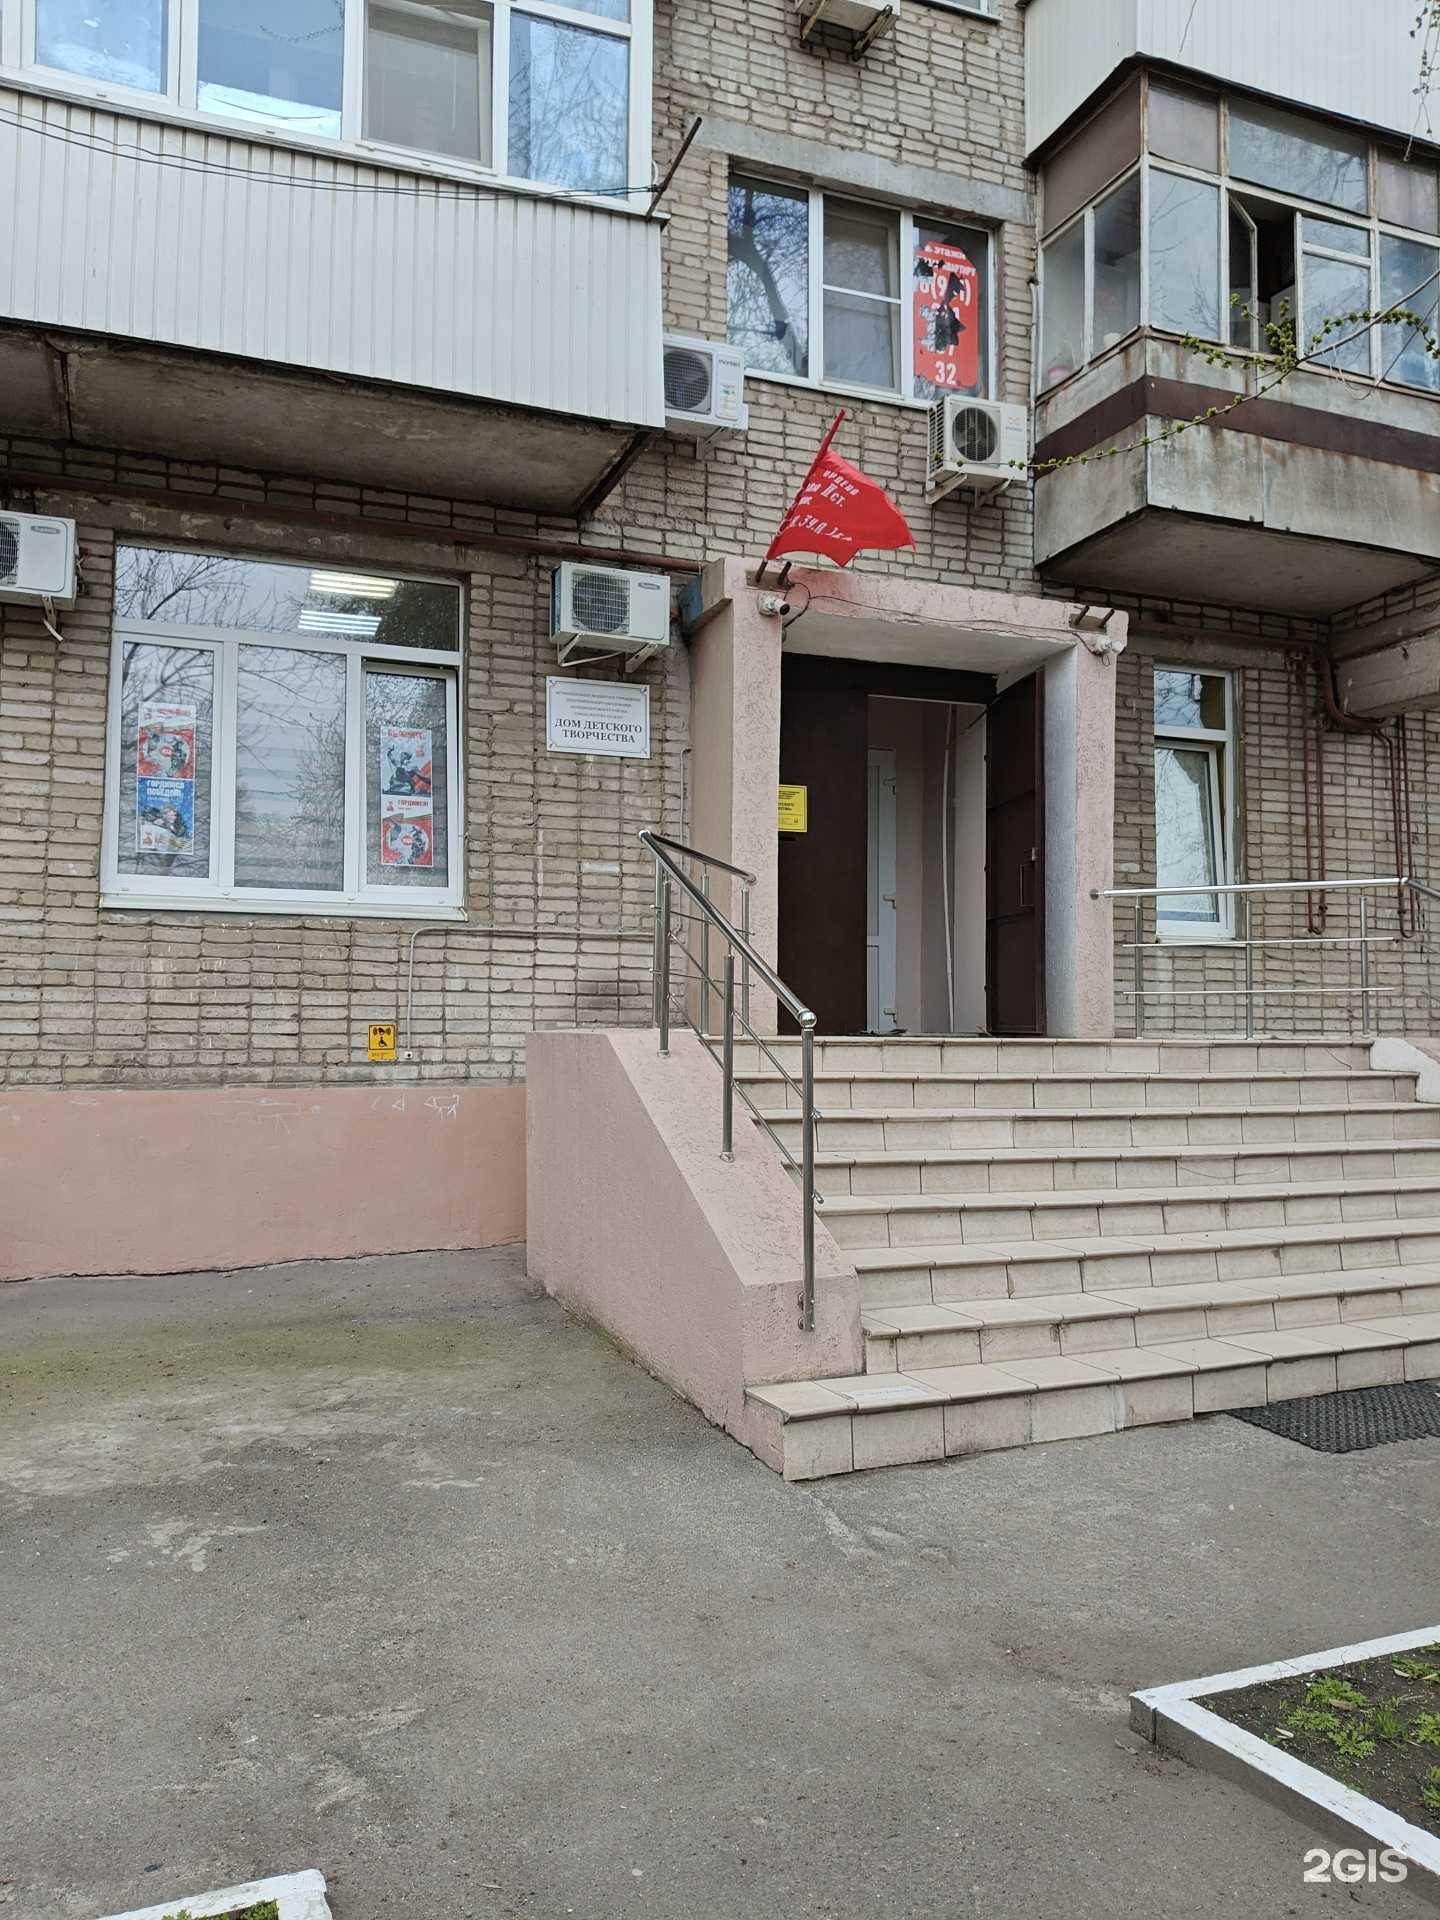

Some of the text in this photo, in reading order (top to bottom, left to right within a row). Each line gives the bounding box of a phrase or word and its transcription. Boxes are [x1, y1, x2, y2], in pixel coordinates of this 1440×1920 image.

[935, 361, 957, 385] 32
[555, 718, 642, 733] ДОМ ДЕТСКОГО
[562, 729, 635, 743] ТВОРЧЕСТВА
